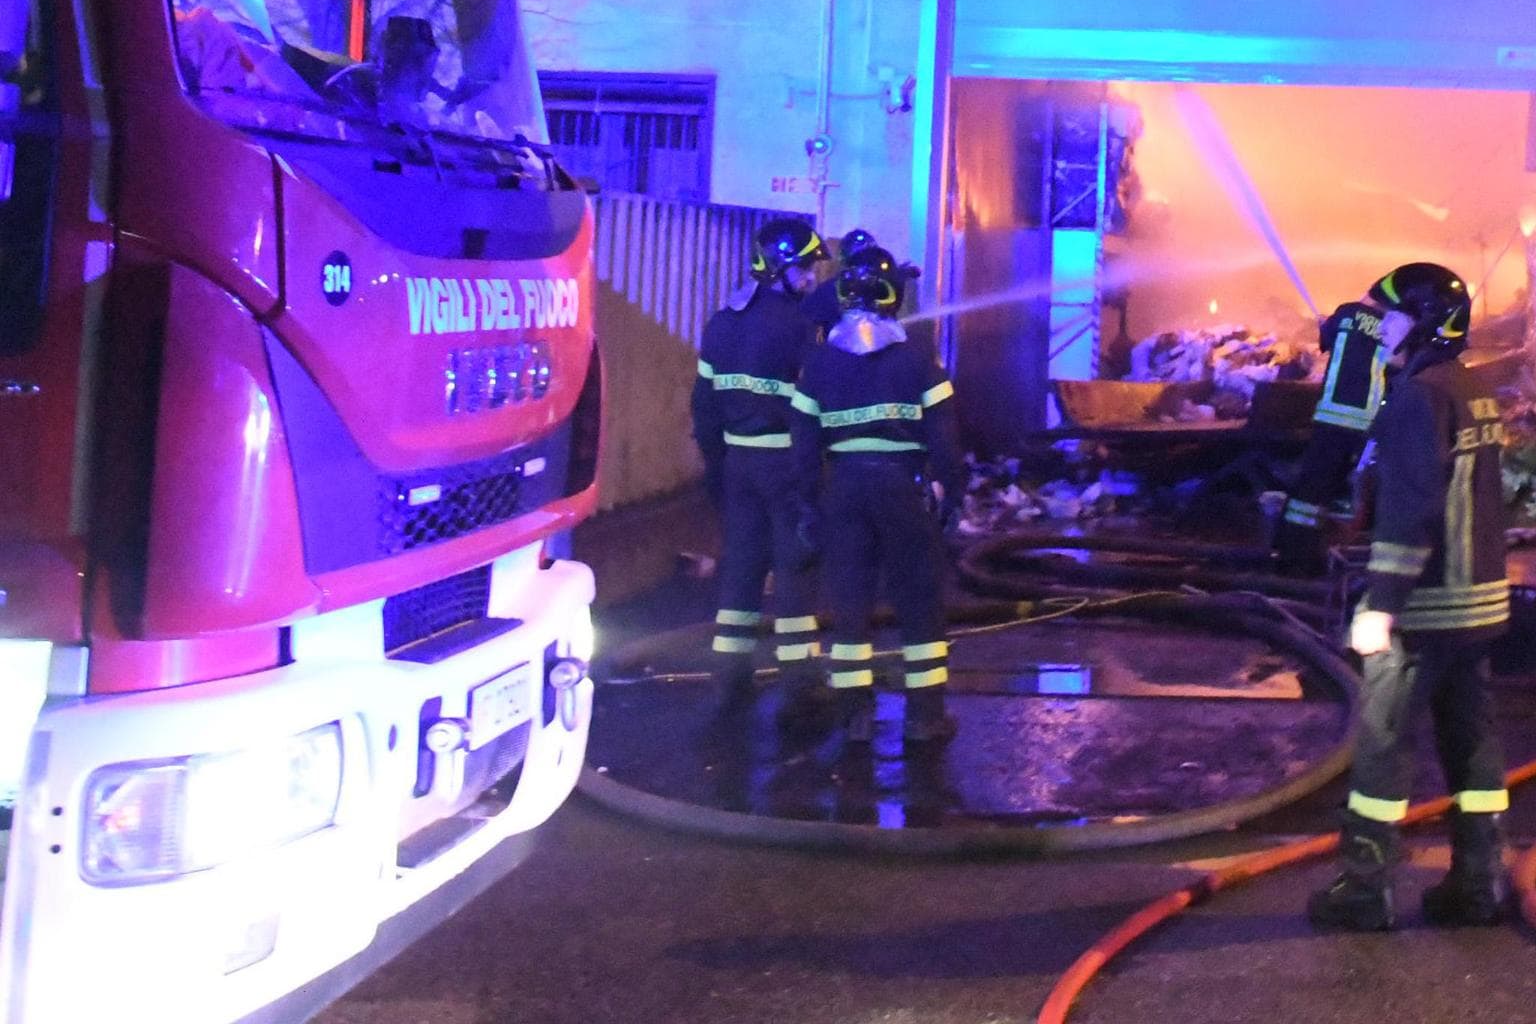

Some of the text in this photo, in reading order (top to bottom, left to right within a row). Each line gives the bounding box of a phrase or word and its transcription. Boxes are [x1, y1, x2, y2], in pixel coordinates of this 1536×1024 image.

[323, 264, 350, 293] 314
[406, 278, 579, 335] VIGILI DEL FUOCO
